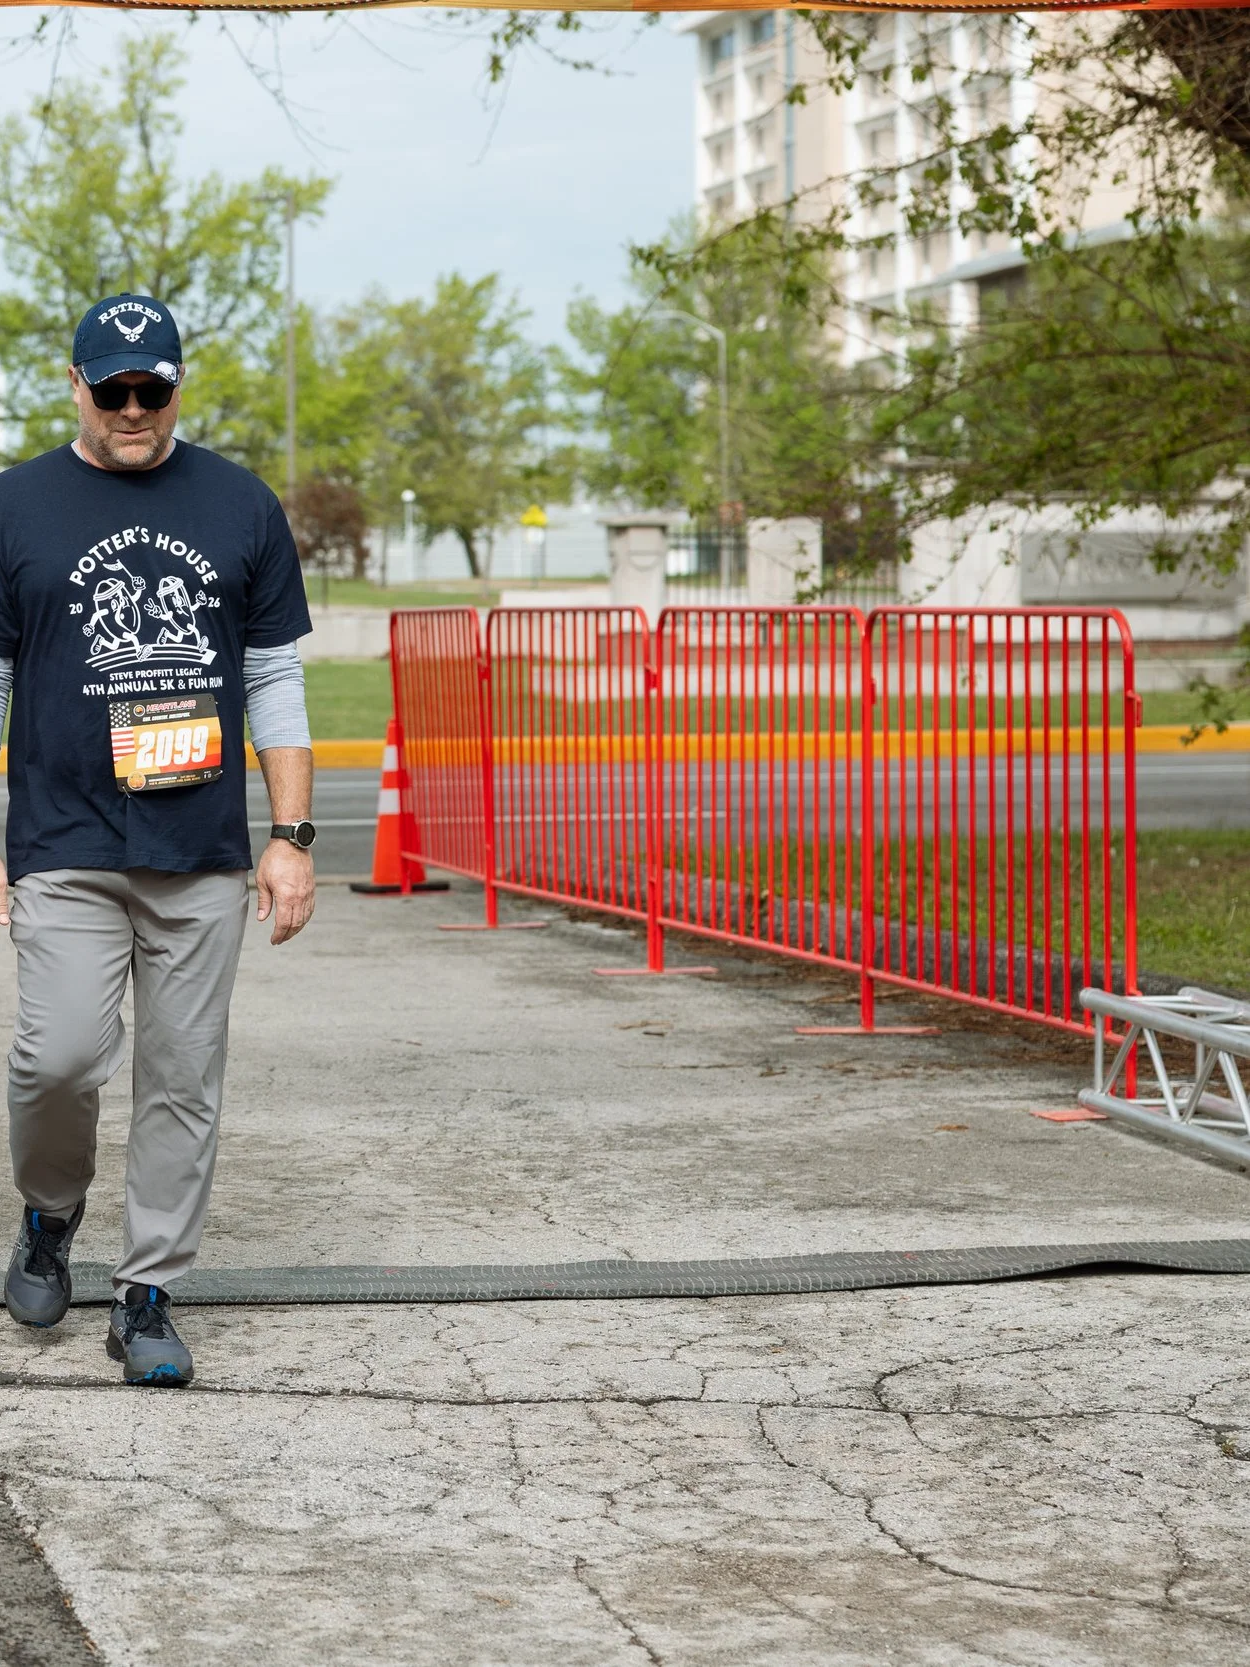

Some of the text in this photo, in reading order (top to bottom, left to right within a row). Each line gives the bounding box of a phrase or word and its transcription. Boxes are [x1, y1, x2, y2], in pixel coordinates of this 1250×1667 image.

[98, 302, 162, 325] RETIRED
[69, 526, 219, 587] POTTER'S HOUSE
[69, 603, 83, 615] 20
[208, 597, 221, 608] 26
[109, 667, 203, 681] STEVE PROFFITT LEGACY
[82, 676, 223, 696] 4TH ANNUAL 5K & FUN RUN
[146, 700, 196, 711] HEARTLAND
[136, 725, 209, 770] 2099
